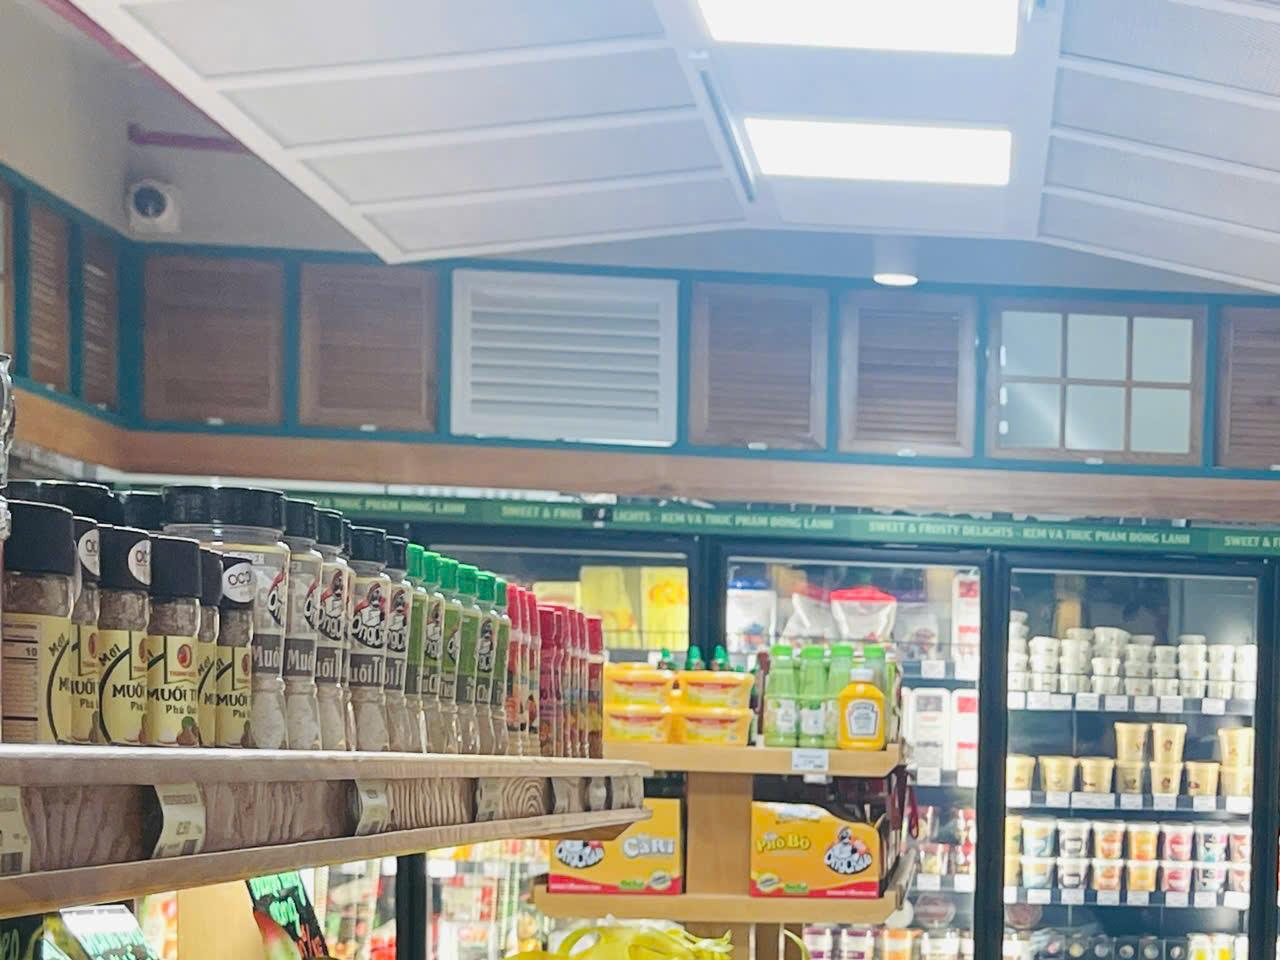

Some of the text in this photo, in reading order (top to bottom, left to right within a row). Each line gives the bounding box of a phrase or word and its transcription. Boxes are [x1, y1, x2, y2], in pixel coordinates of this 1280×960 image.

[613, 510, 651, 522] LIGHTS
[868, 521, 905, 532] SWEET
[908, 523, 916, 533] &
[918, 523, 961, 535] FROSTY
[963, 525, 1013, 537] DELIGHTS
[1023, 527, 1047, 539] KEM
[1224, 535, 1260, 547] SWEET
[1262, 537, 1271, 547] &
[252, 646, 281, 668] Muố
